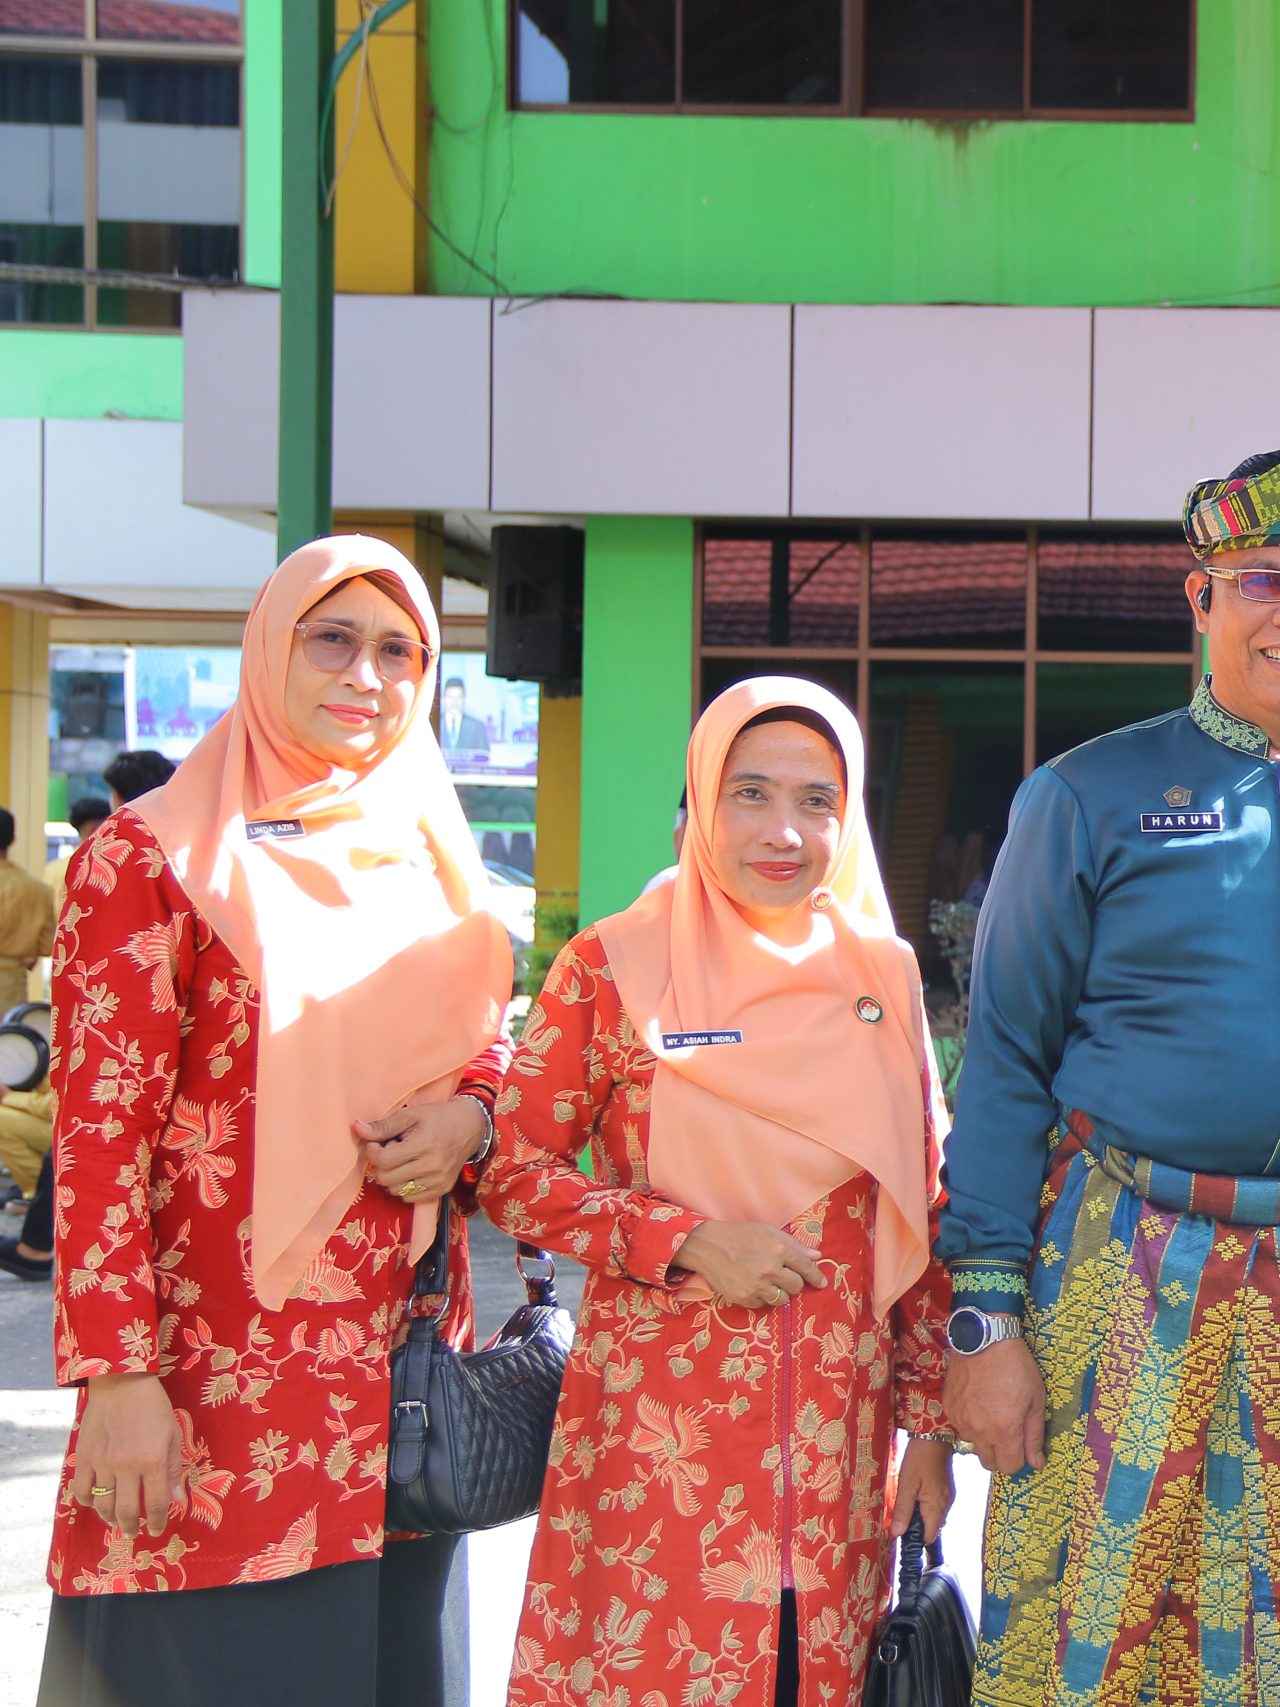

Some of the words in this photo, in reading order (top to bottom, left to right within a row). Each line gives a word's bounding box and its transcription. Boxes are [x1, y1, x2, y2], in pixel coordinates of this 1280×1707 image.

[1151, 814, 1213, 827] HARUN
[249, 825, 276, 835] LINDA
[277, 823, 296, 832] AZIS
[666, 1037, 681, 1046] NY.
[682, 1036, 709, 1045] ASIAH
[711, 1034, 738, 1043] INDRA
